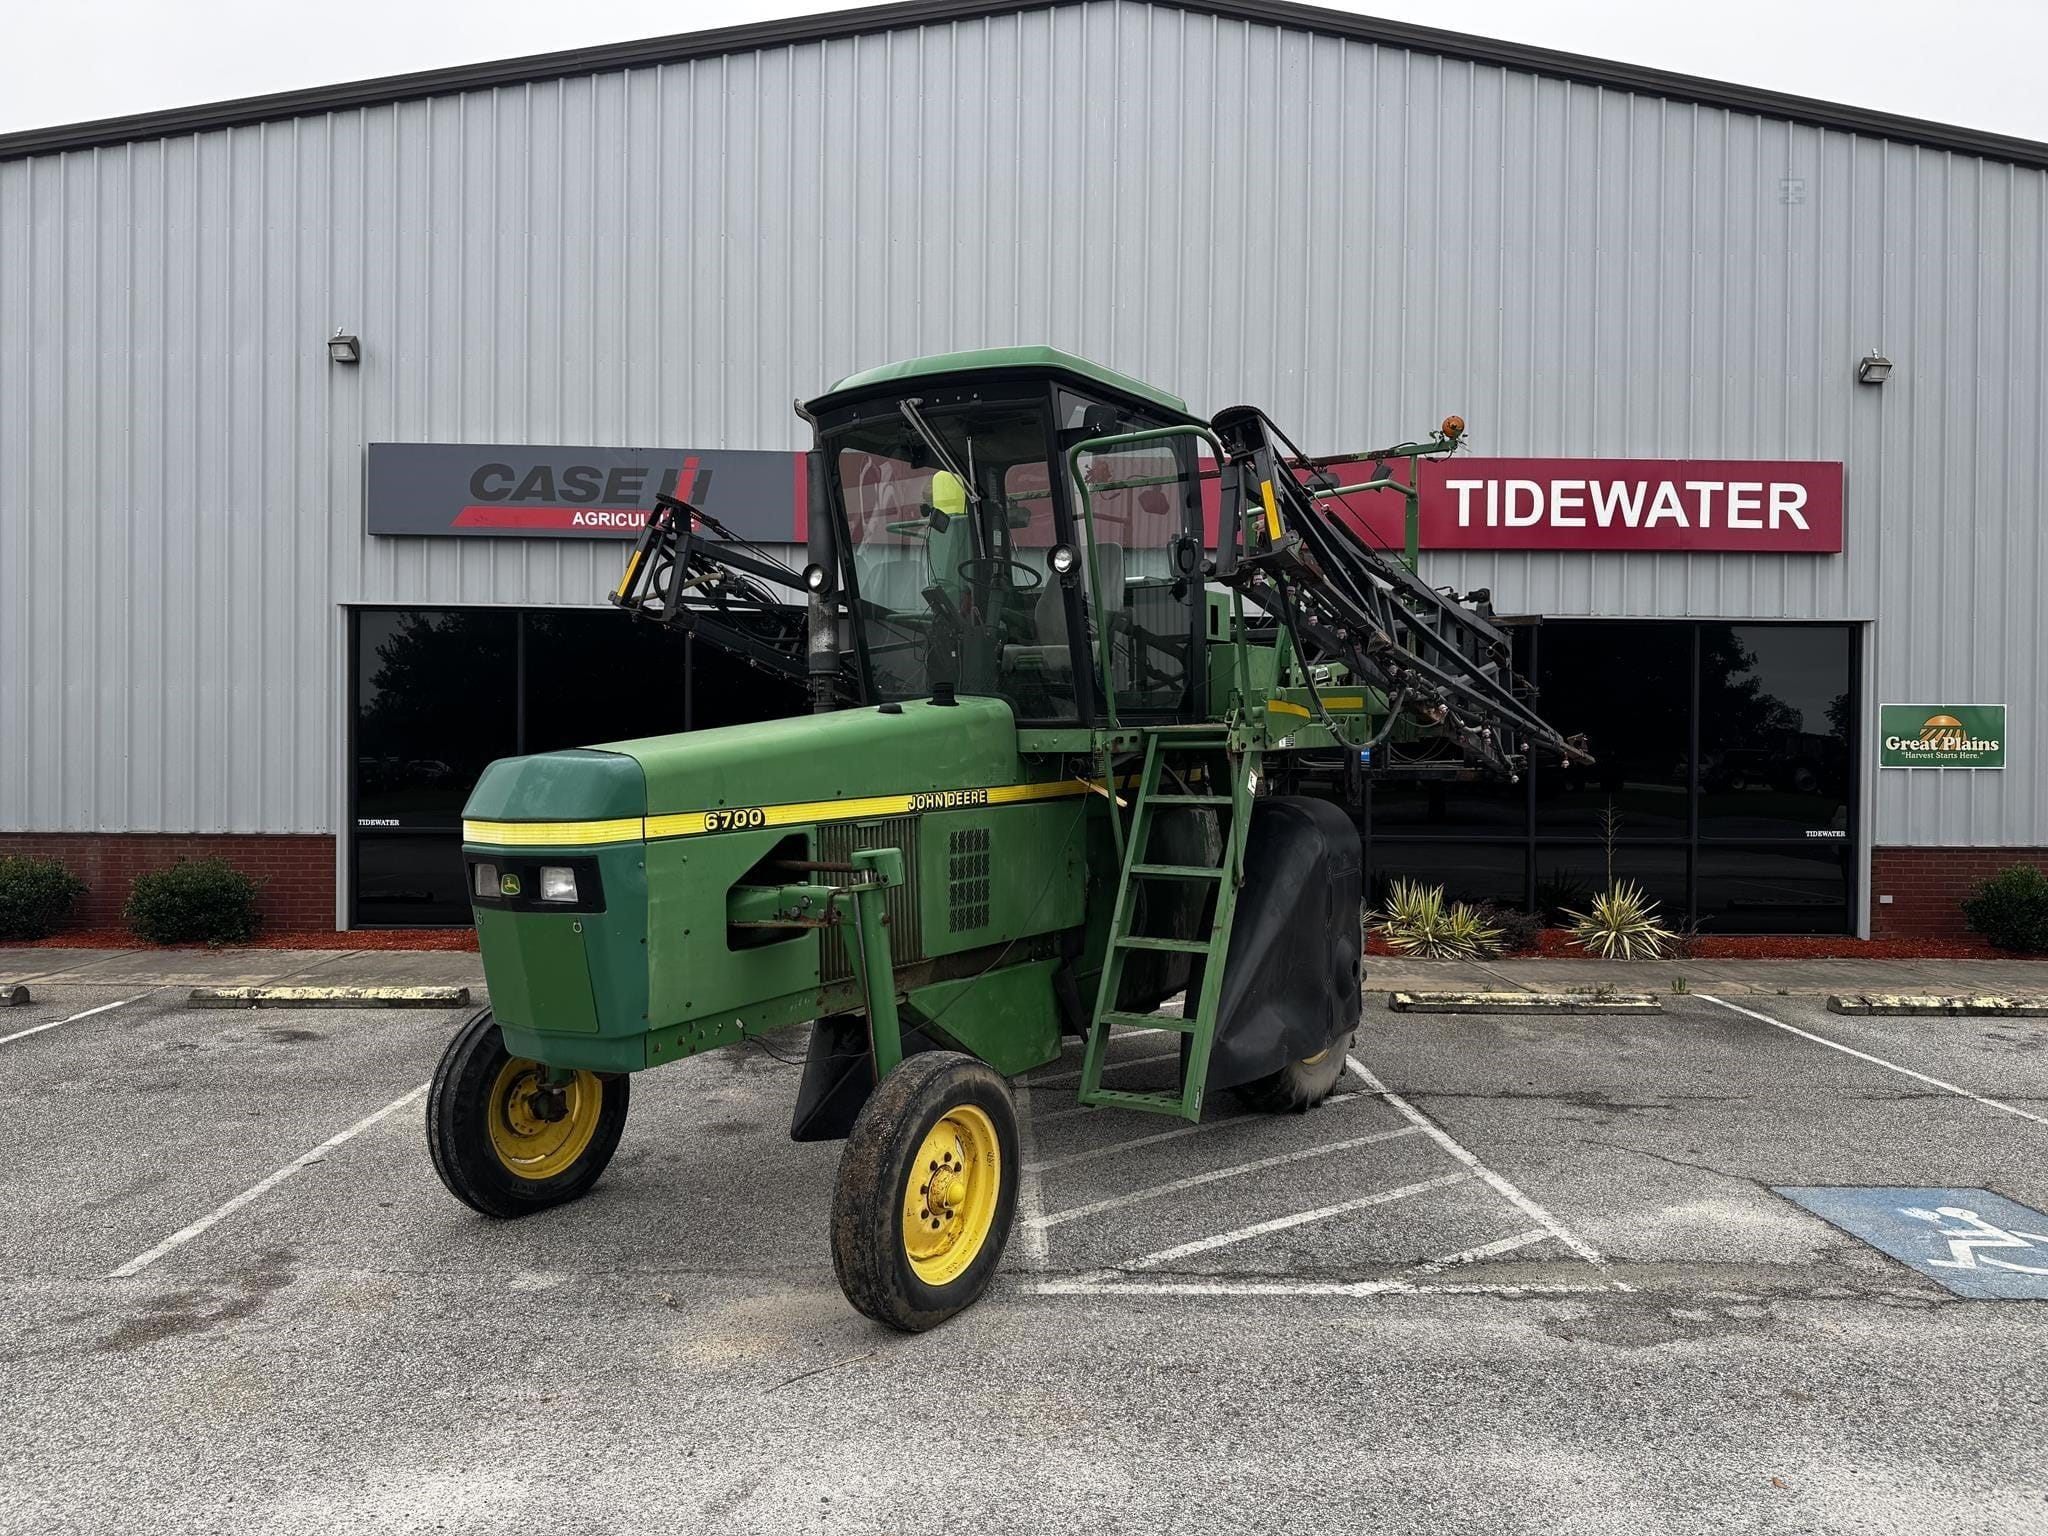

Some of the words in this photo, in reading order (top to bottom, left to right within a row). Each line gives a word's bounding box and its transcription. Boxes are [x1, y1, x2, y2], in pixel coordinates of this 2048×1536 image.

[470, 463, 648, 504] CASE
[1446, 479, 1810, 530] TIDEWATER
[572, 511, 698, 529] AGRICUL
[1885, 736, 1939, 751] Great
[1942, 736, 2000, 751] Plains
[907, 794, 943, 811] JOHN
[946, 788, 987, 807] DEERE
[704, 808, 765, 831] 6700
